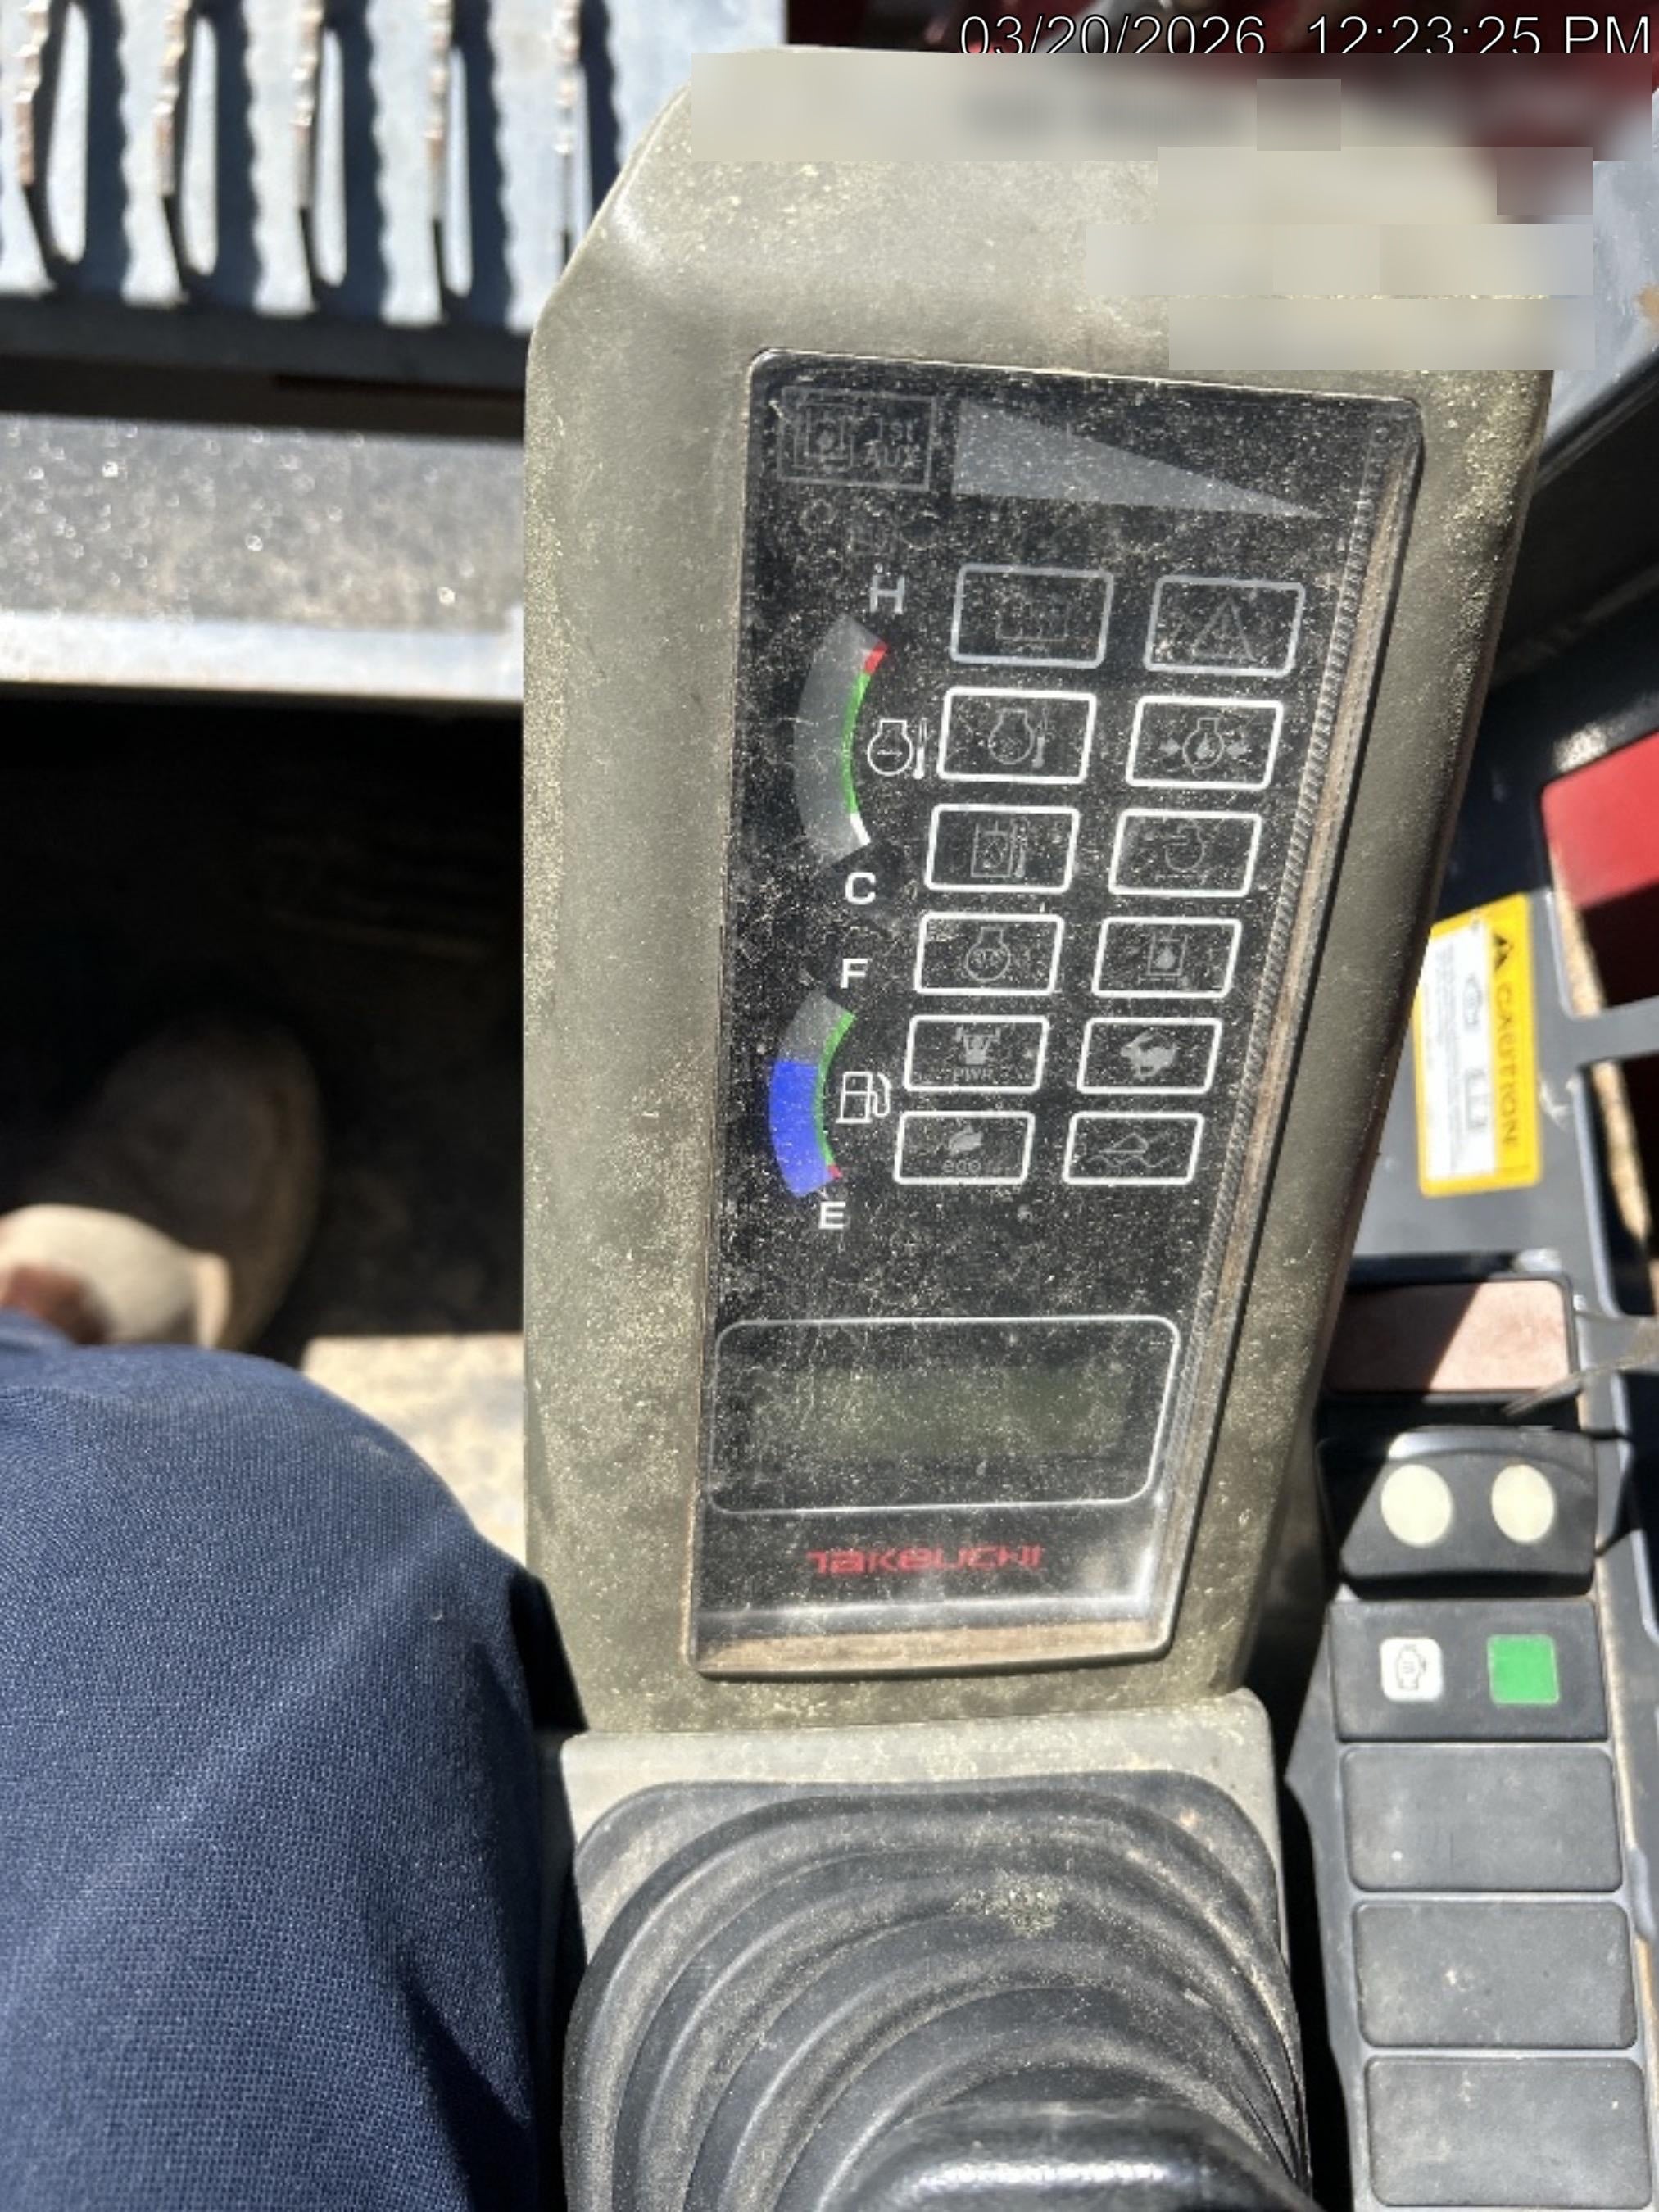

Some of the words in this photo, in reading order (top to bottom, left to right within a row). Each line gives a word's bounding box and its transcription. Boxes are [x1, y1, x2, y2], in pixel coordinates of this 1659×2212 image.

[870, 575, 905, 615] H
[845, 871, 877, 905] C
[840, 958, 870, 990] F
[1495, 982, 1519, 1145] CAUTION
[818, 1202, 847, 1230] E
